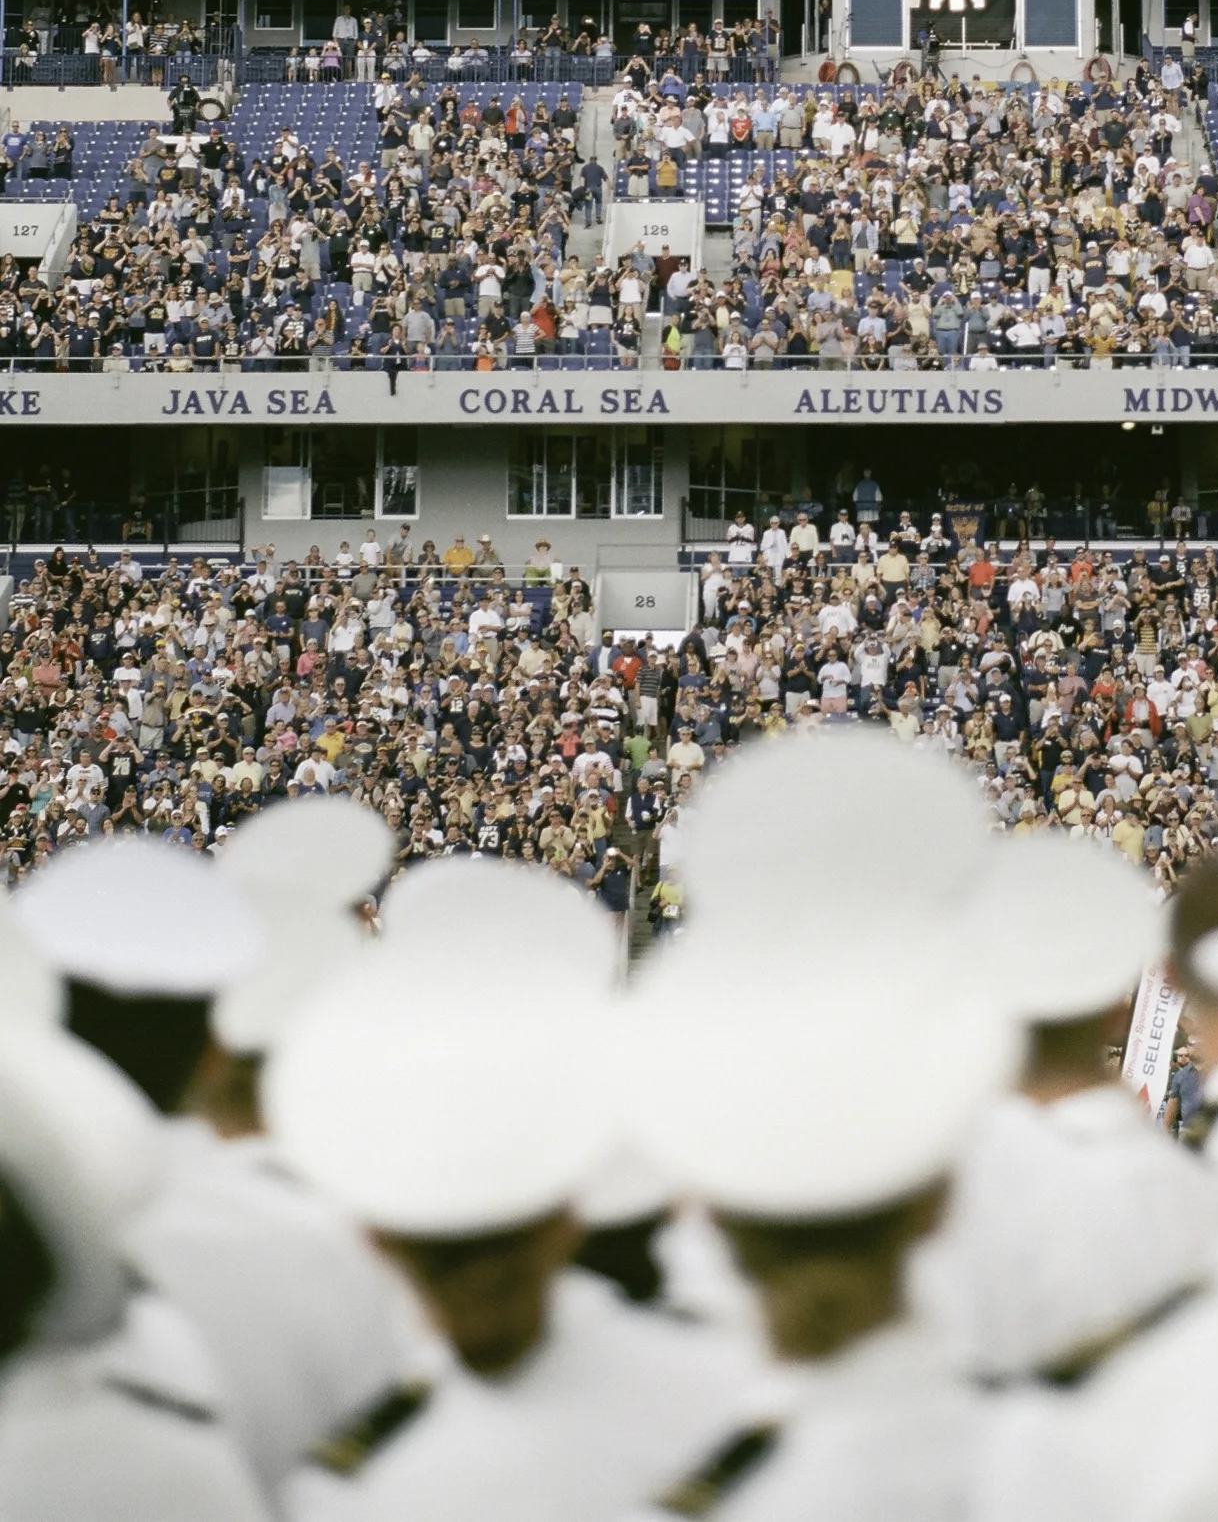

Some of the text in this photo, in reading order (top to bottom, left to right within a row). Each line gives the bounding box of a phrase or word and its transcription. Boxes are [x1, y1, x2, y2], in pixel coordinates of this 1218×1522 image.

[13, 225, 39, 237] 127
[431, 227, 445, 239] 12
[643, 225, 669, 236] 128
[162, 389, 337, 415] JAVA SEA
[459, 388, 670, 414] CORAL SEA
[794, 389, 1003, 414] ALEUTIANS
[634, 595, 656, 609] 28
[449, 699, 463, 713] 12
[477, 831, 499, 849] 73
